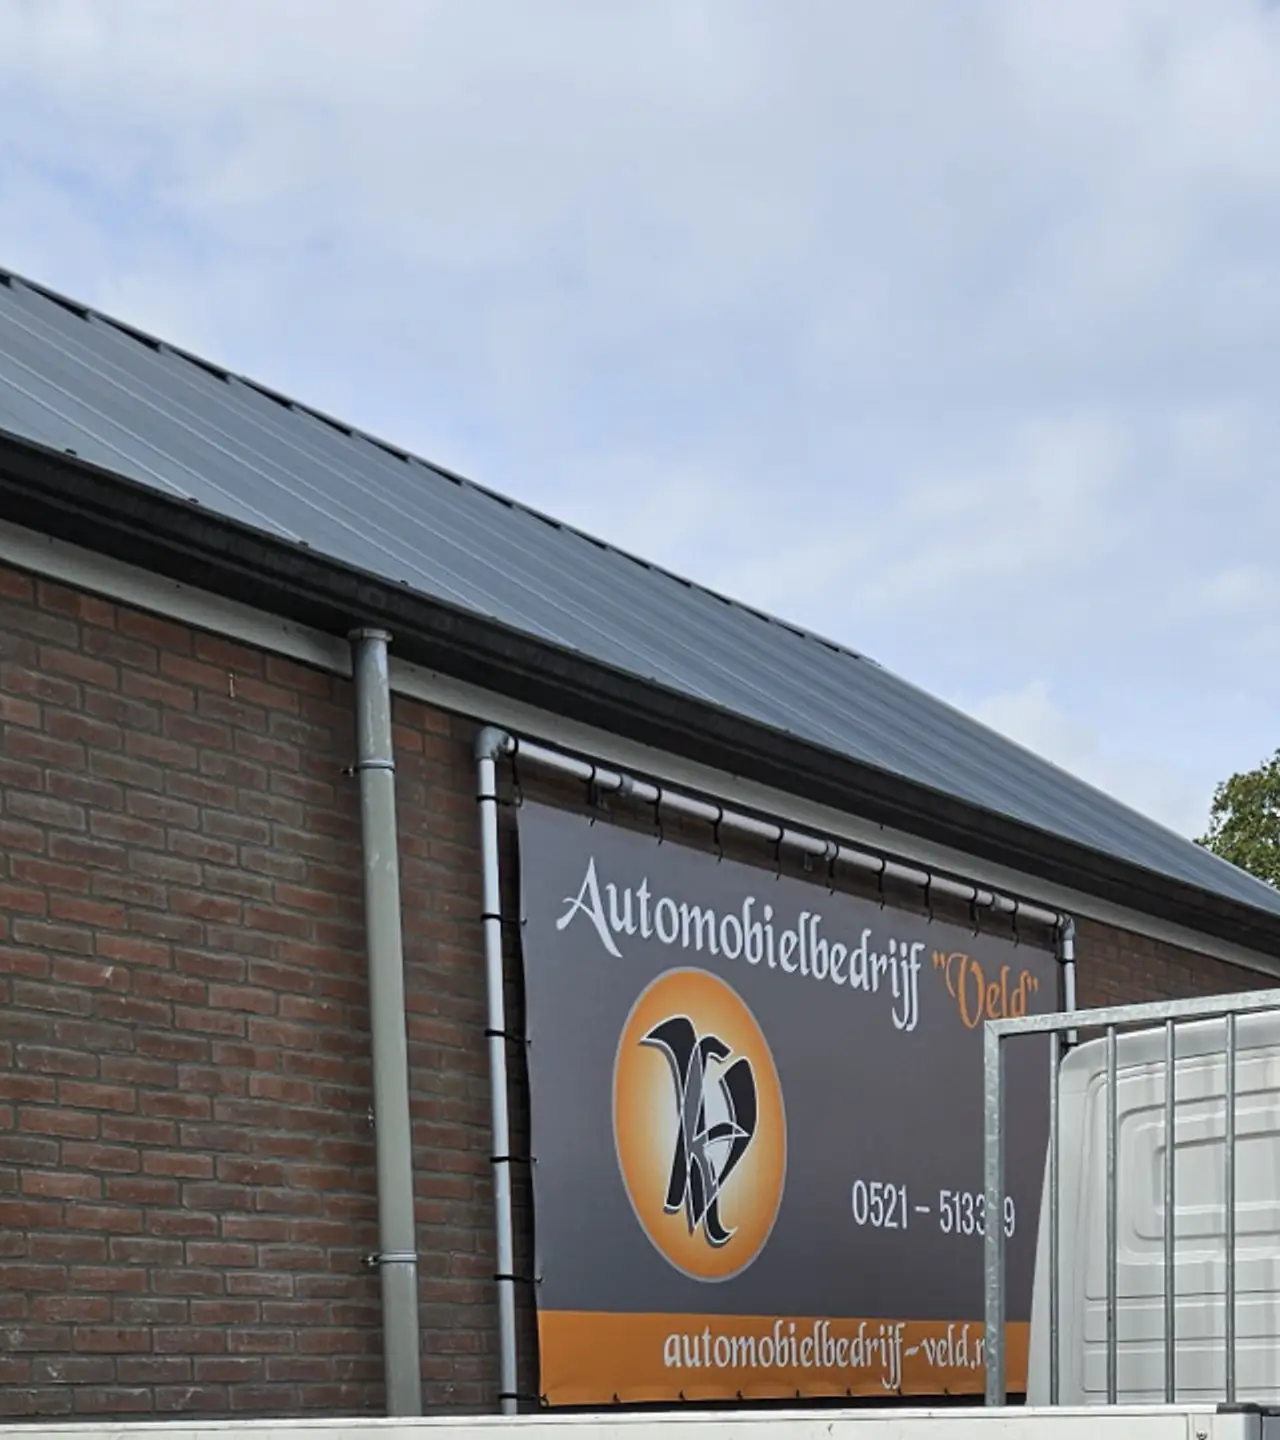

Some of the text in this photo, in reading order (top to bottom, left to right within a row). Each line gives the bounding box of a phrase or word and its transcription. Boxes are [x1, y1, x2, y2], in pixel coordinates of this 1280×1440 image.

[556, 856, 1039, 1031] Automobielbedrijf "Veld"
[852, 1180, 908, 1229] 0521
[939, 1190, 1016, 1238] 51339
[663, 1320, 987, 1389] automobielbedrijf-veld.n
